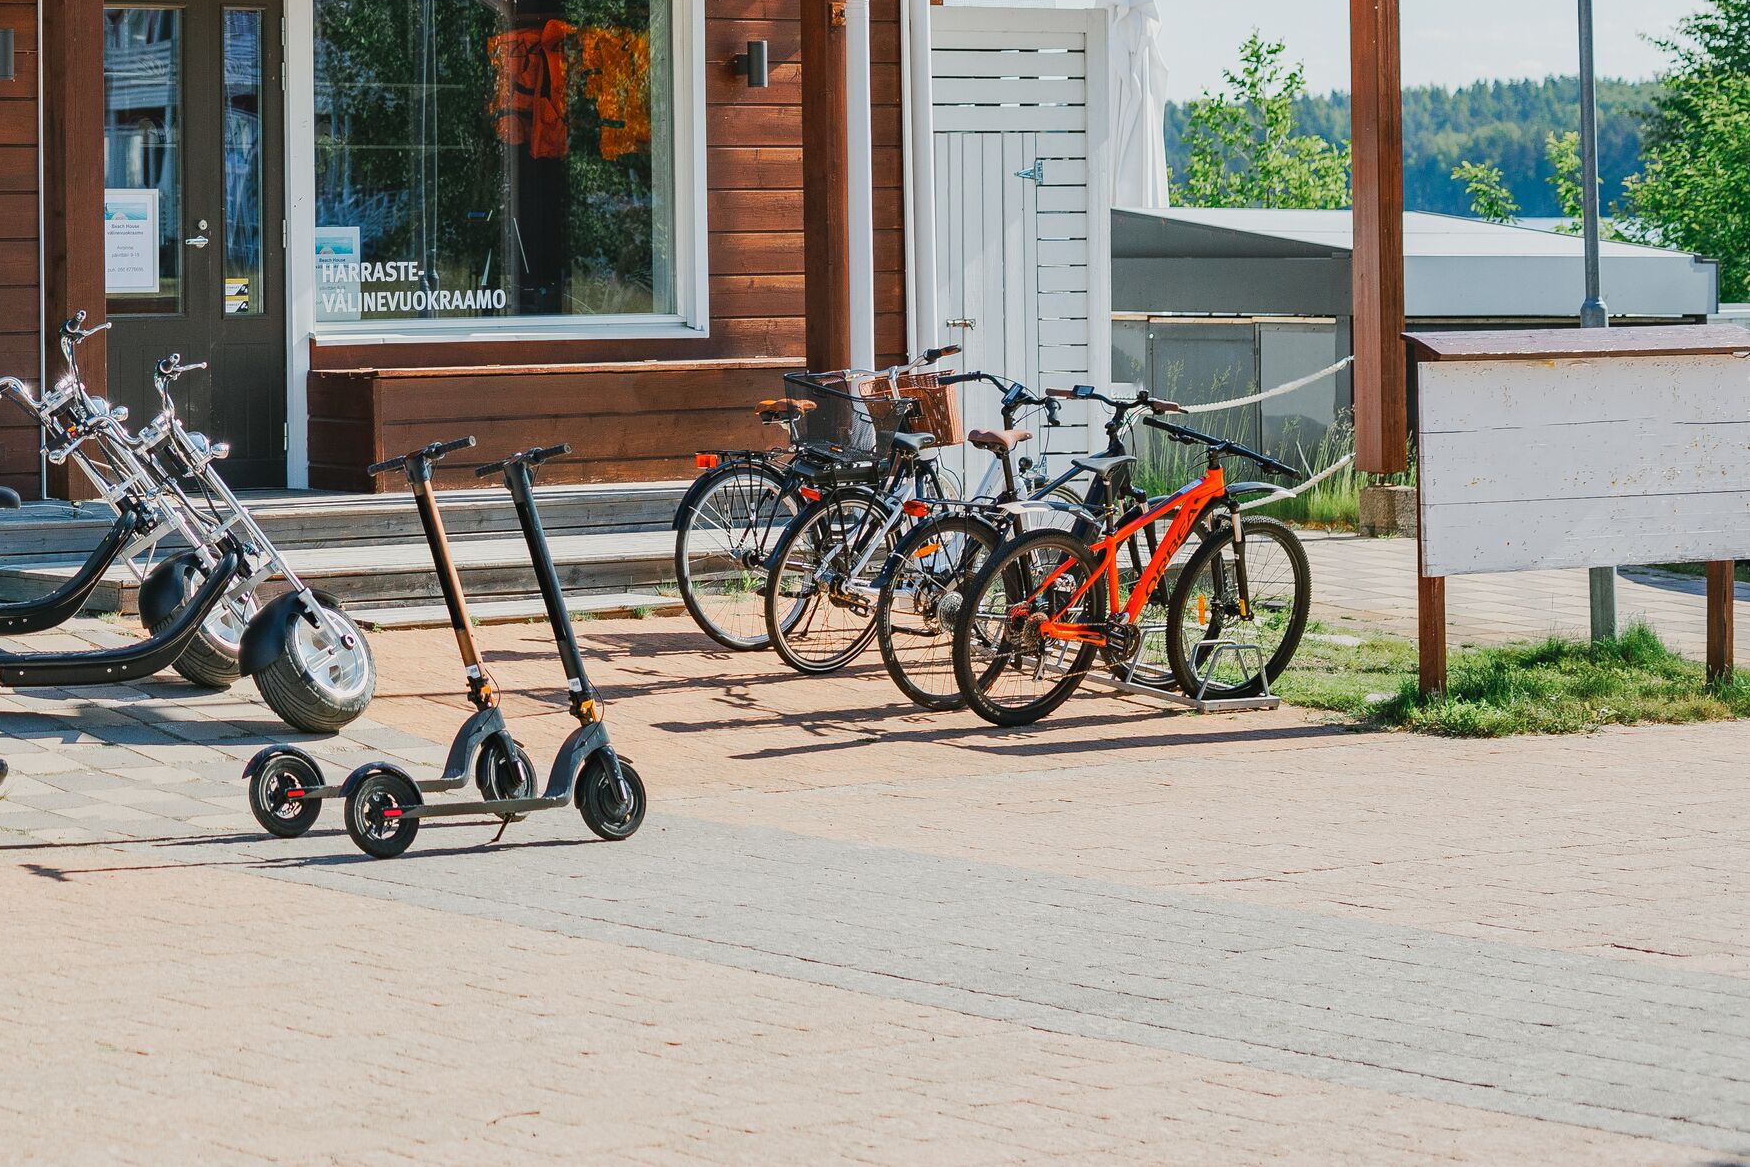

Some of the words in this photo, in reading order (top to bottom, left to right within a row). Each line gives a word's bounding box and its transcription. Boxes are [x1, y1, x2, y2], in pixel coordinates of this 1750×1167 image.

[322, 261, 425, 283] HARRASTE-
[322, 288, 507, 313] VÄLINEVUOKRAAMO
[1146, 508, 1198, 597] ORBEA
